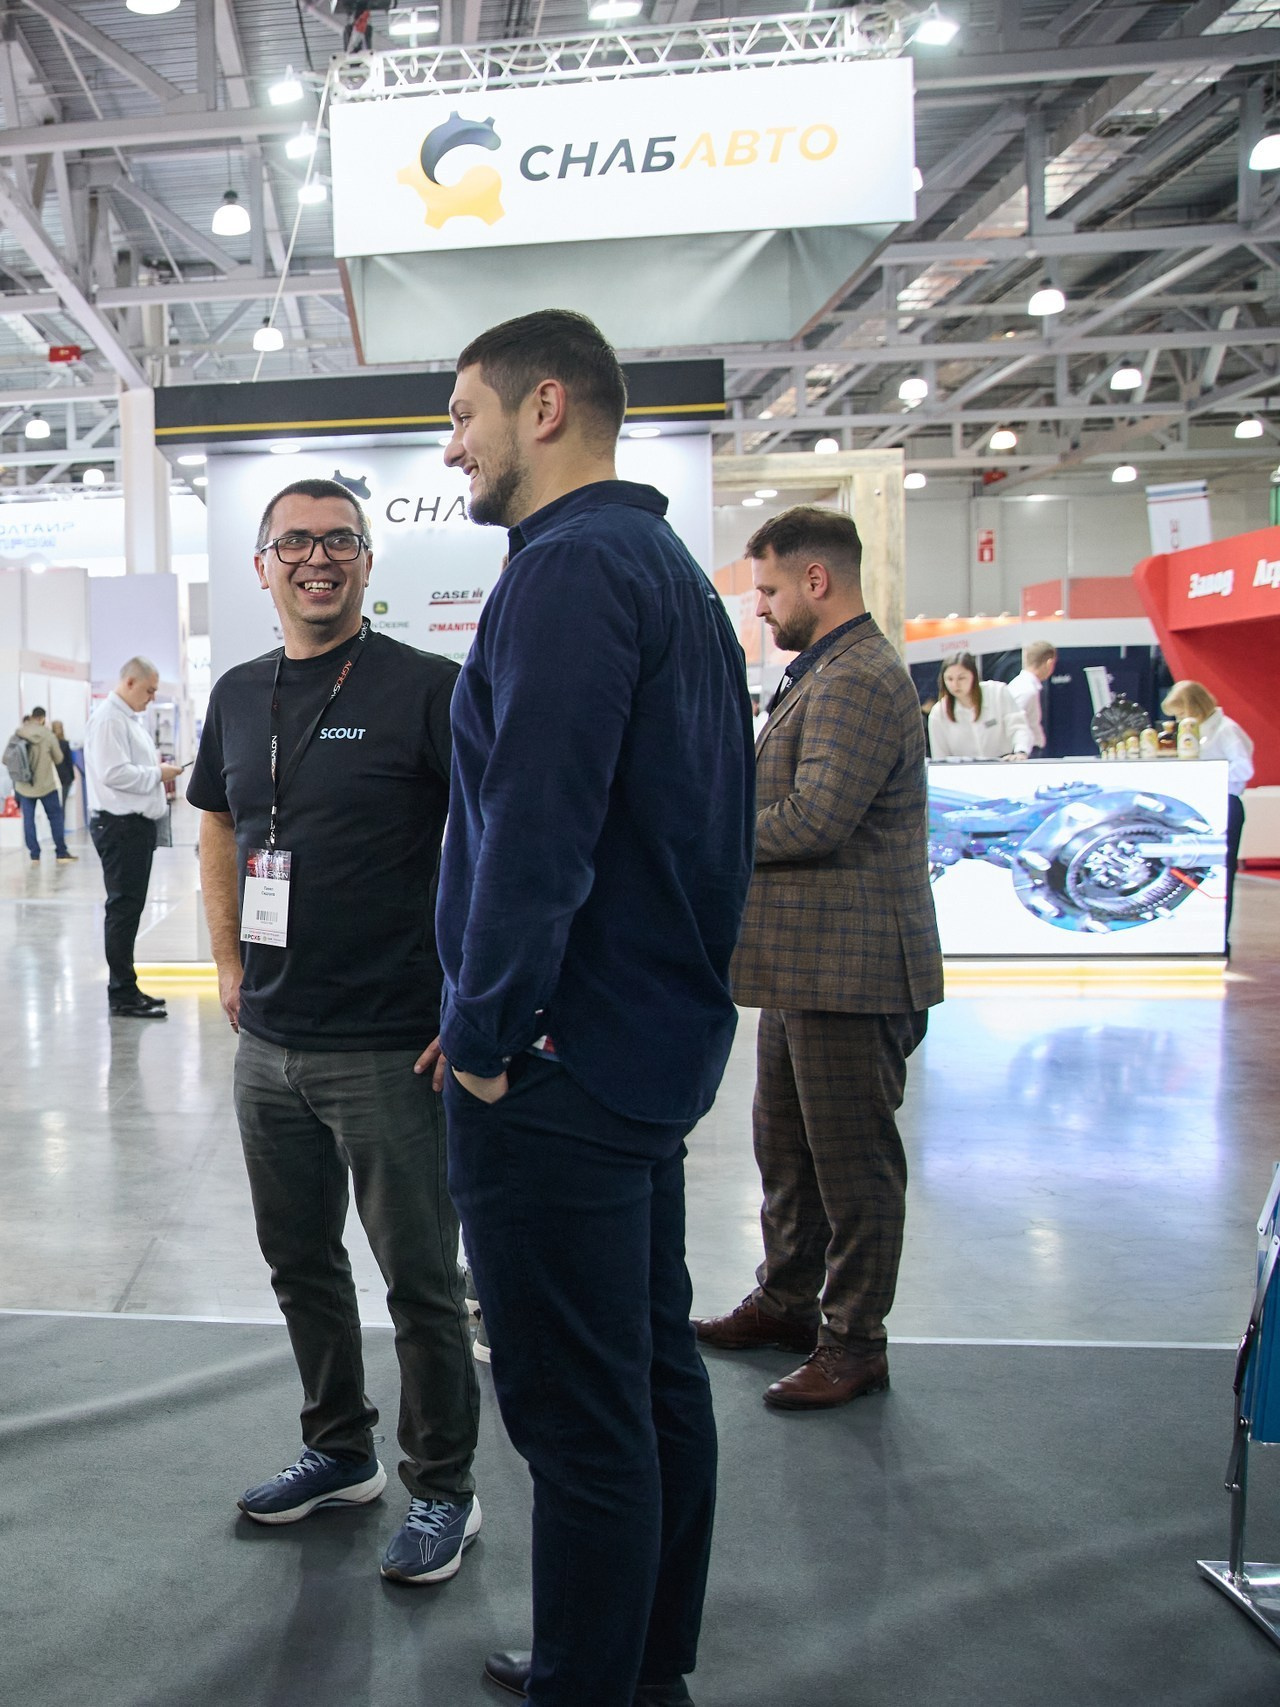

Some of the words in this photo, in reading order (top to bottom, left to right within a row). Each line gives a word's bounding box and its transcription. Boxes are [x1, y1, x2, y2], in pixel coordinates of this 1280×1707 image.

[519, 123, 839, 182] СНАБАВТО
[431, 590, 470, 600] CASE
[320, 728, 366, 740] SCOUT
